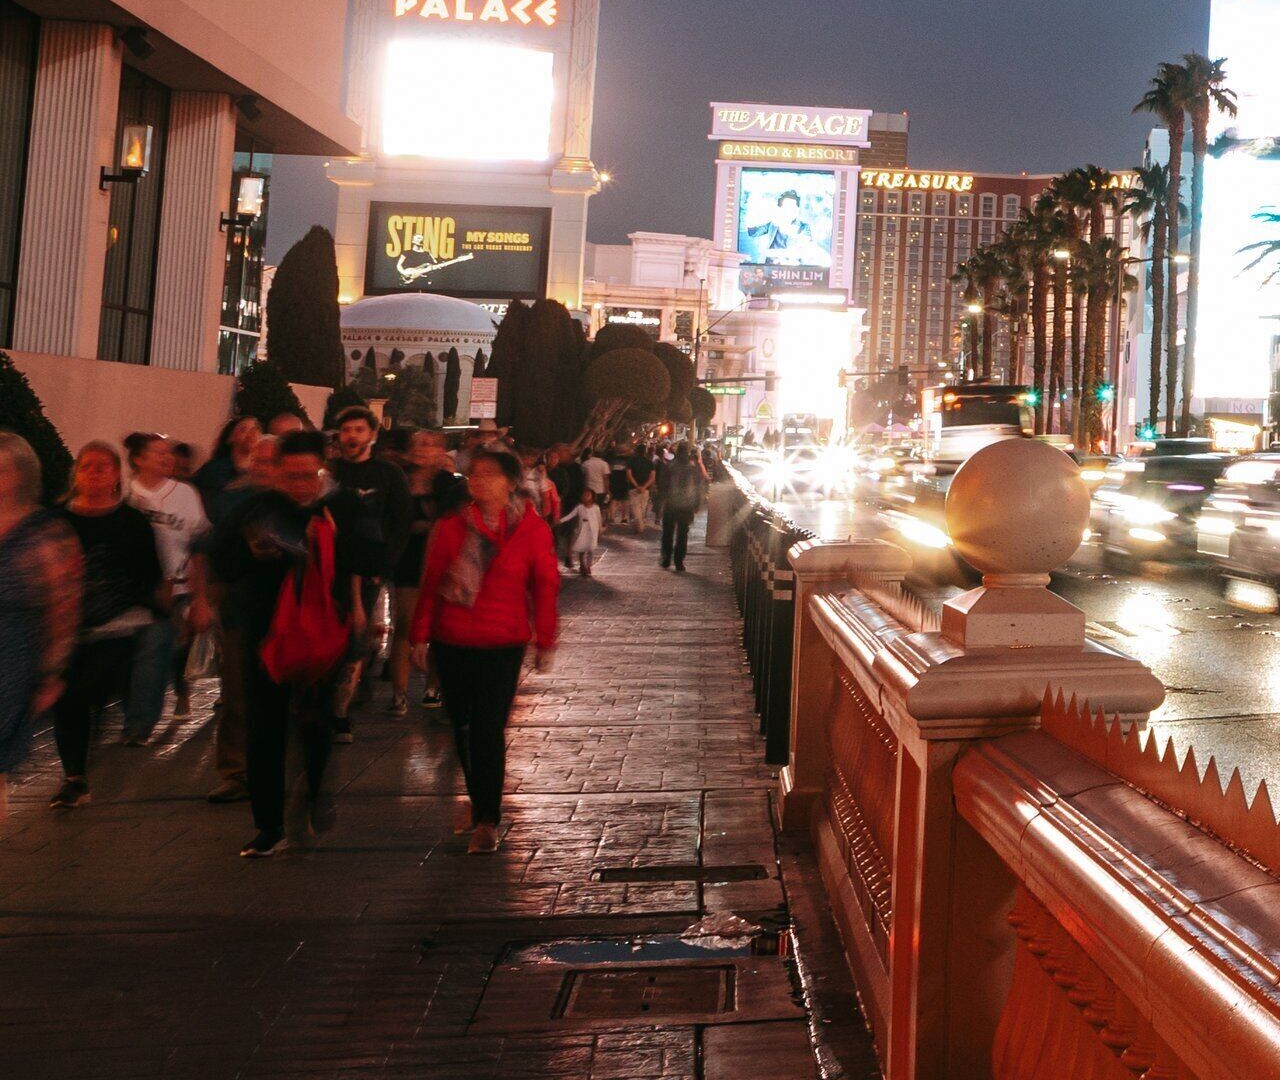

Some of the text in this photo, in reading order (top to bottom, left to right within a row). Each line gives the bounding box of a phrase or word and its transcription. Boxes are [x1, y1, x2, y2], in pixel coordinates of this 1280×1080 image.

[718, 110, 864, 139] THE MIRAGE
[722, 144, 857, 161] CASINO & RESORT
[861, 171, 974, 192] TREASURE
[385, 214, 456, 260] STING
[466, 231, 530, 244] MY SONGS
[771, 270, 824, 281] SHIN LIM
